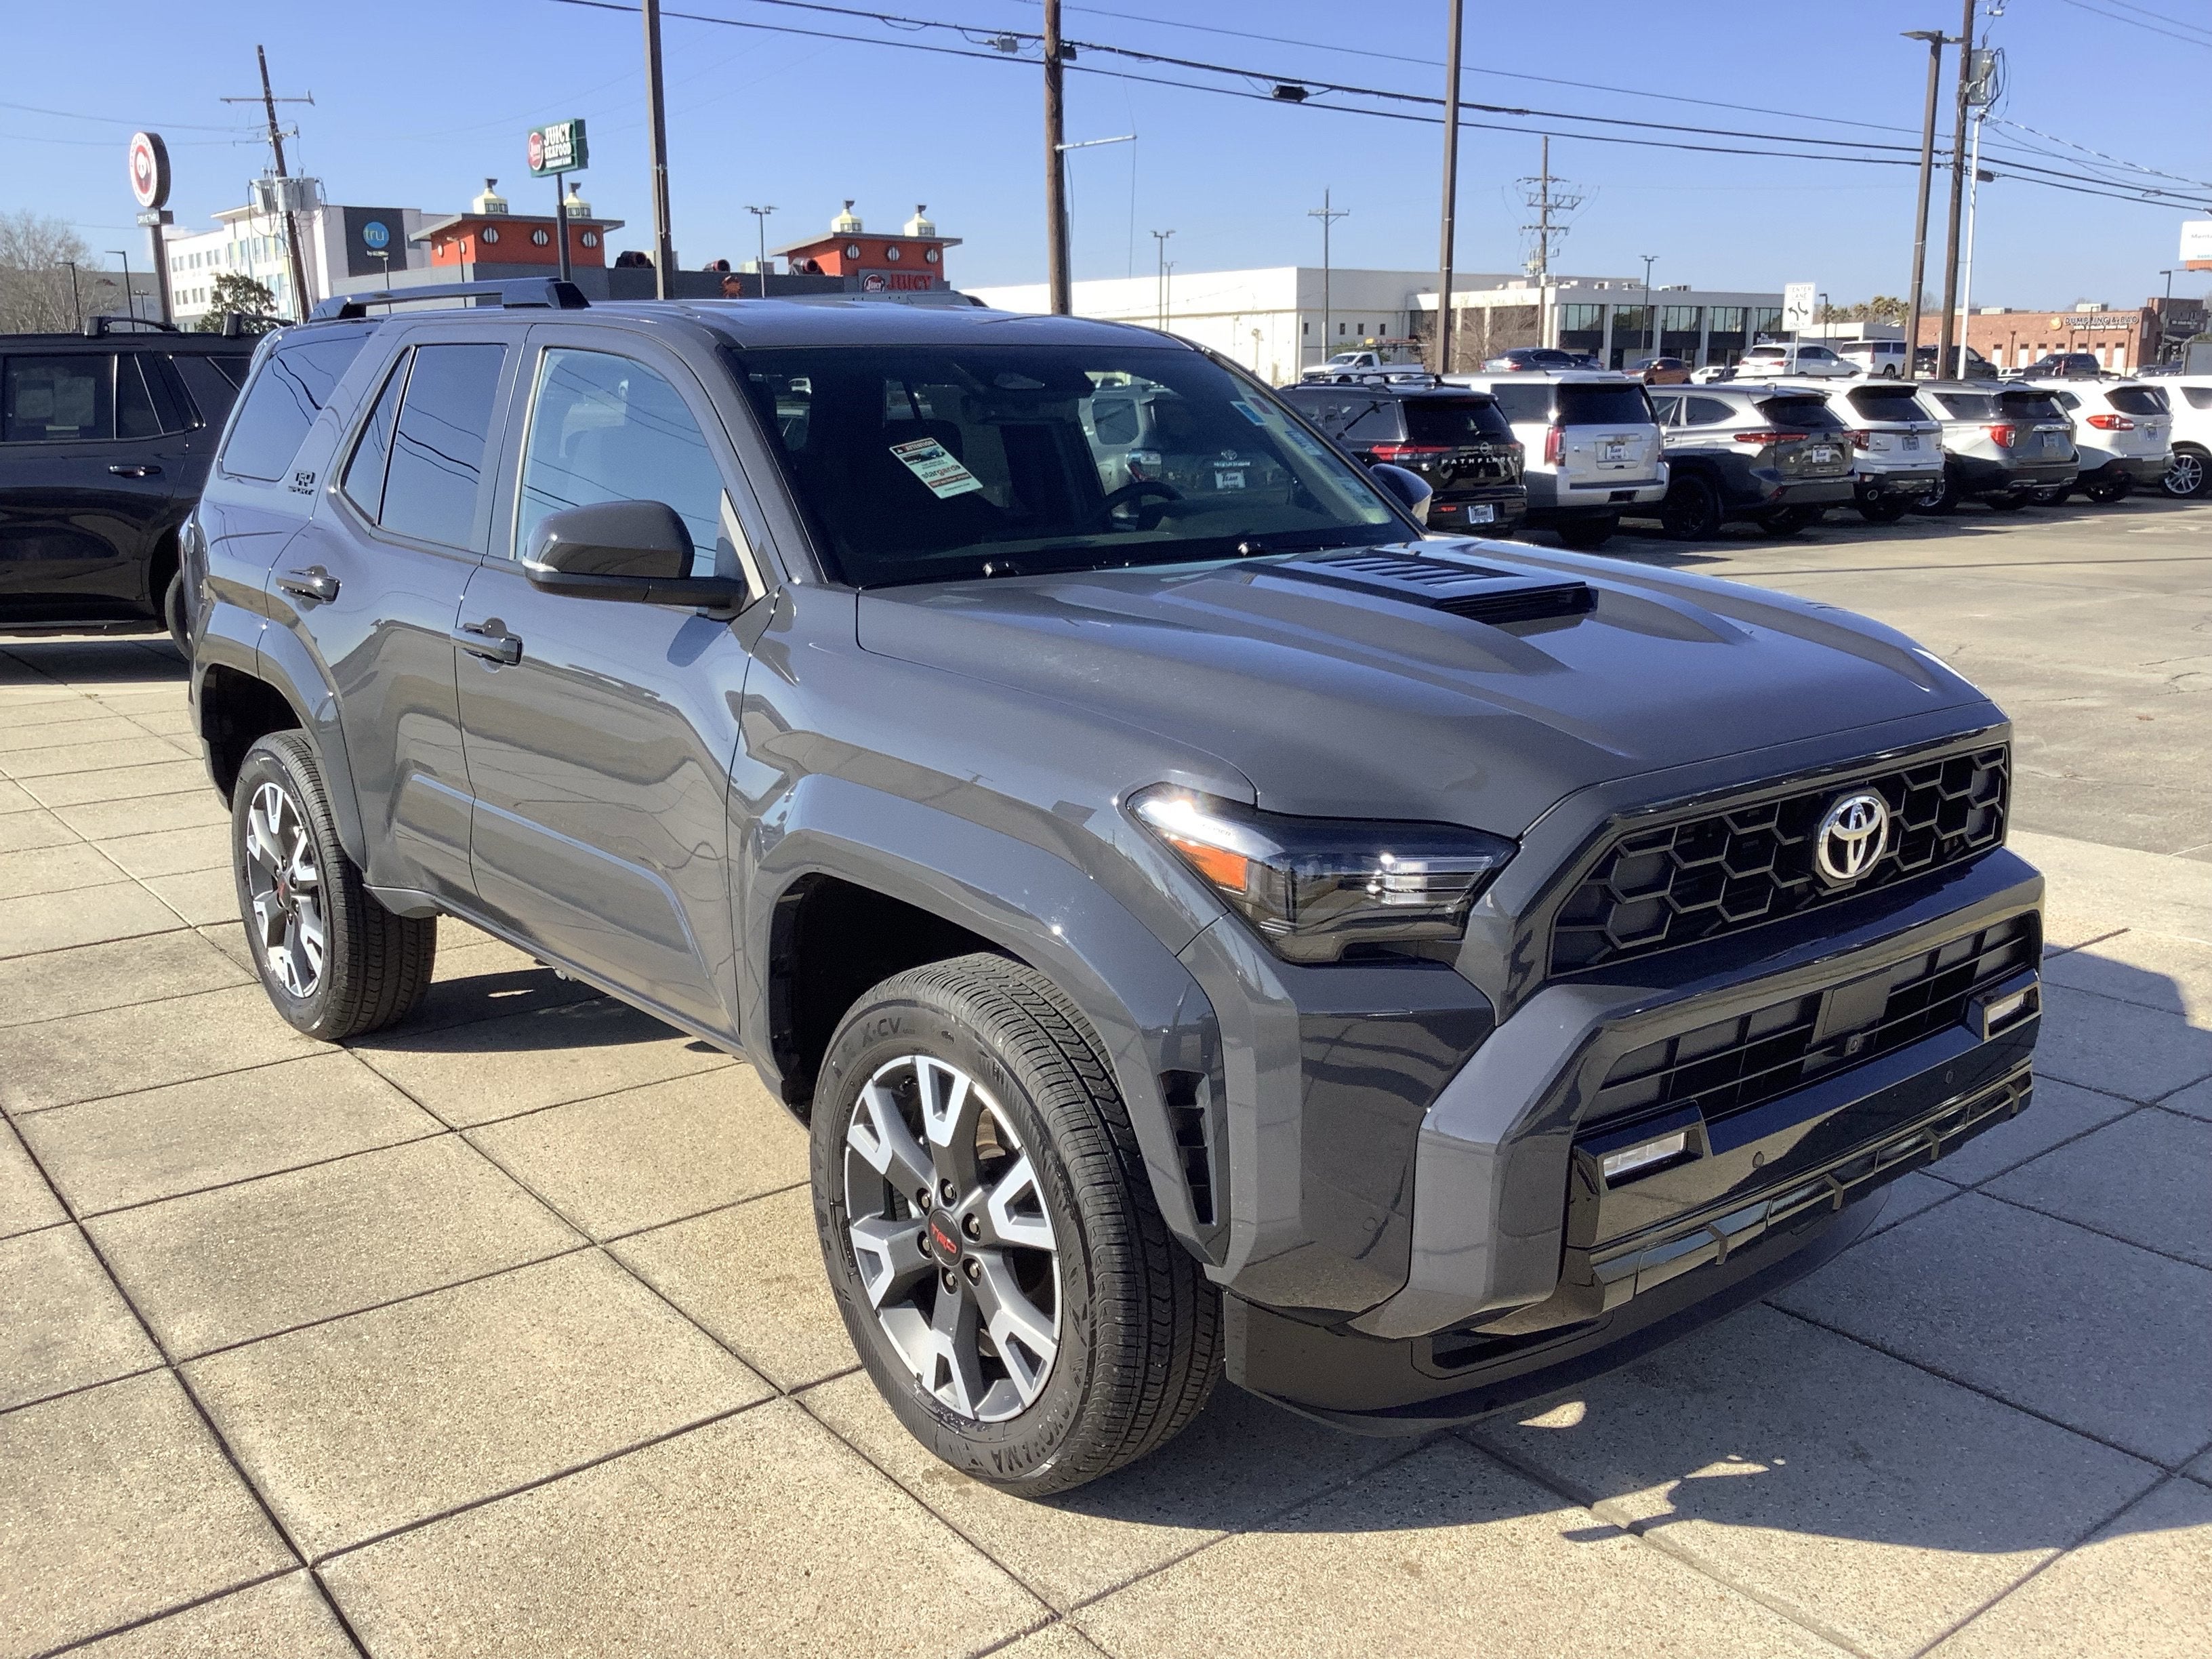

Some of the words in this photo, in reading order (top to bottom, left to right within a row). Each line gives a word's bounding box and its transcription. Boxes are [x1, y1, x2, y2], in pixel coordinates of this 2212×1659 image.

[544, 123, 570, 146] JUICY
[544, 142, 572, 159] SEAFOOD
[363, 228, 384, 241] tru
[886, 274, 933, 290] JUICY
[931, 1222, 957, 1254] TRD
